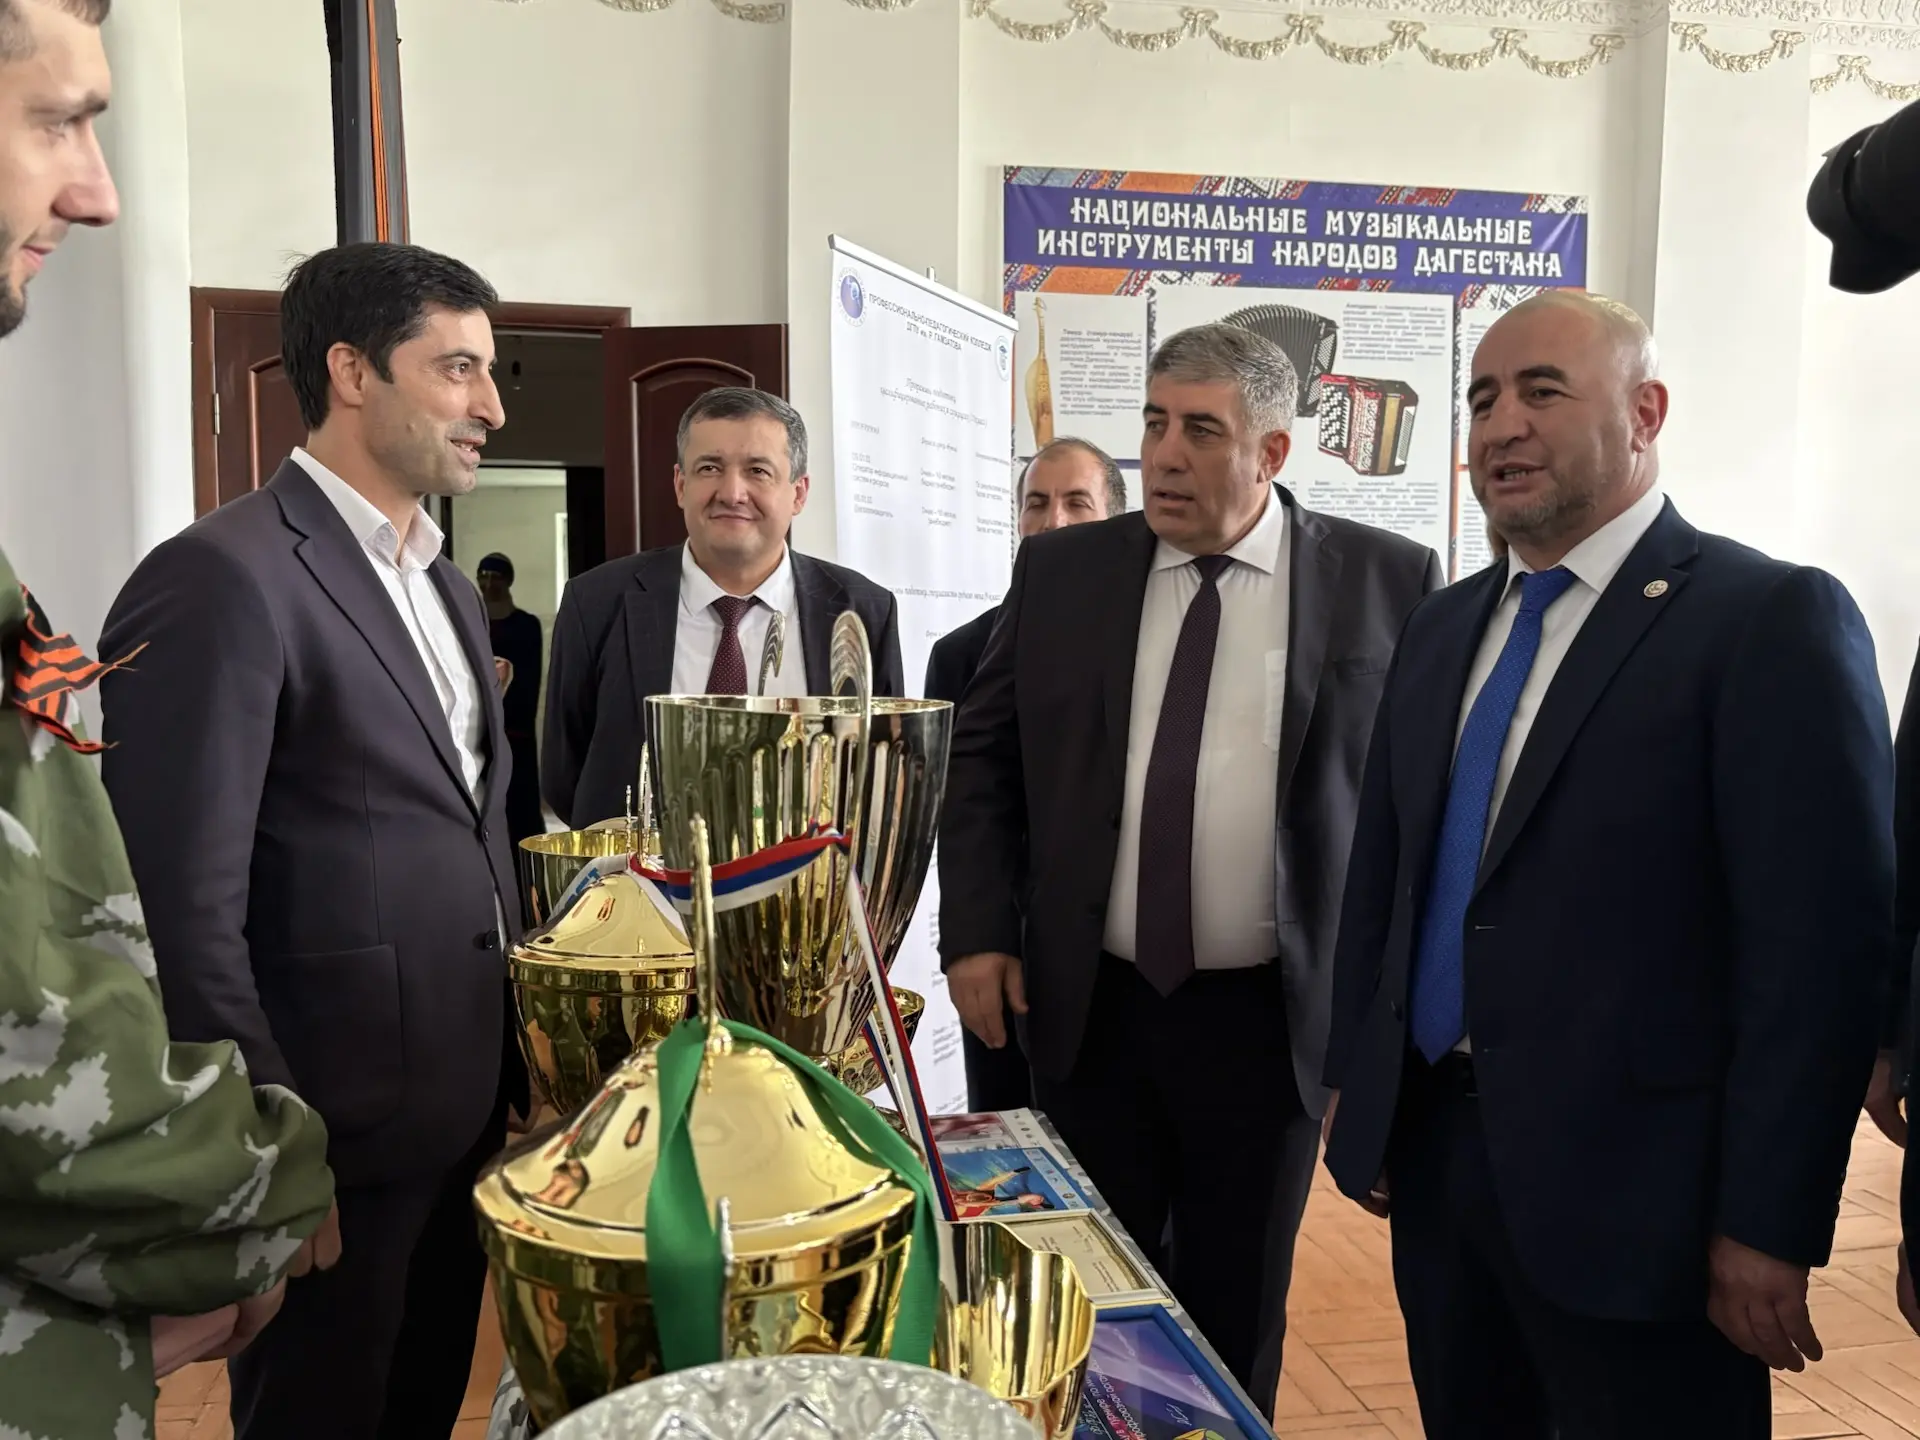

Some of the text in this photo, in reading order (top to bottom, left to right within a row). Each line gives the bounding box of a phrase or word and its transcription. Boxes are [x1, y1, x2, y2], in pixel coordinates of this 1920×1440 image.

[1070, 196, 1532, 245] НАЦИОНАЛЬНЫЕ МУЗЫКАЛЬНЫЕ
[1037, 229, 1562, 277] ИНСТРУМЕНТЫ НАРОДОВ ДАГЕСТАНА
